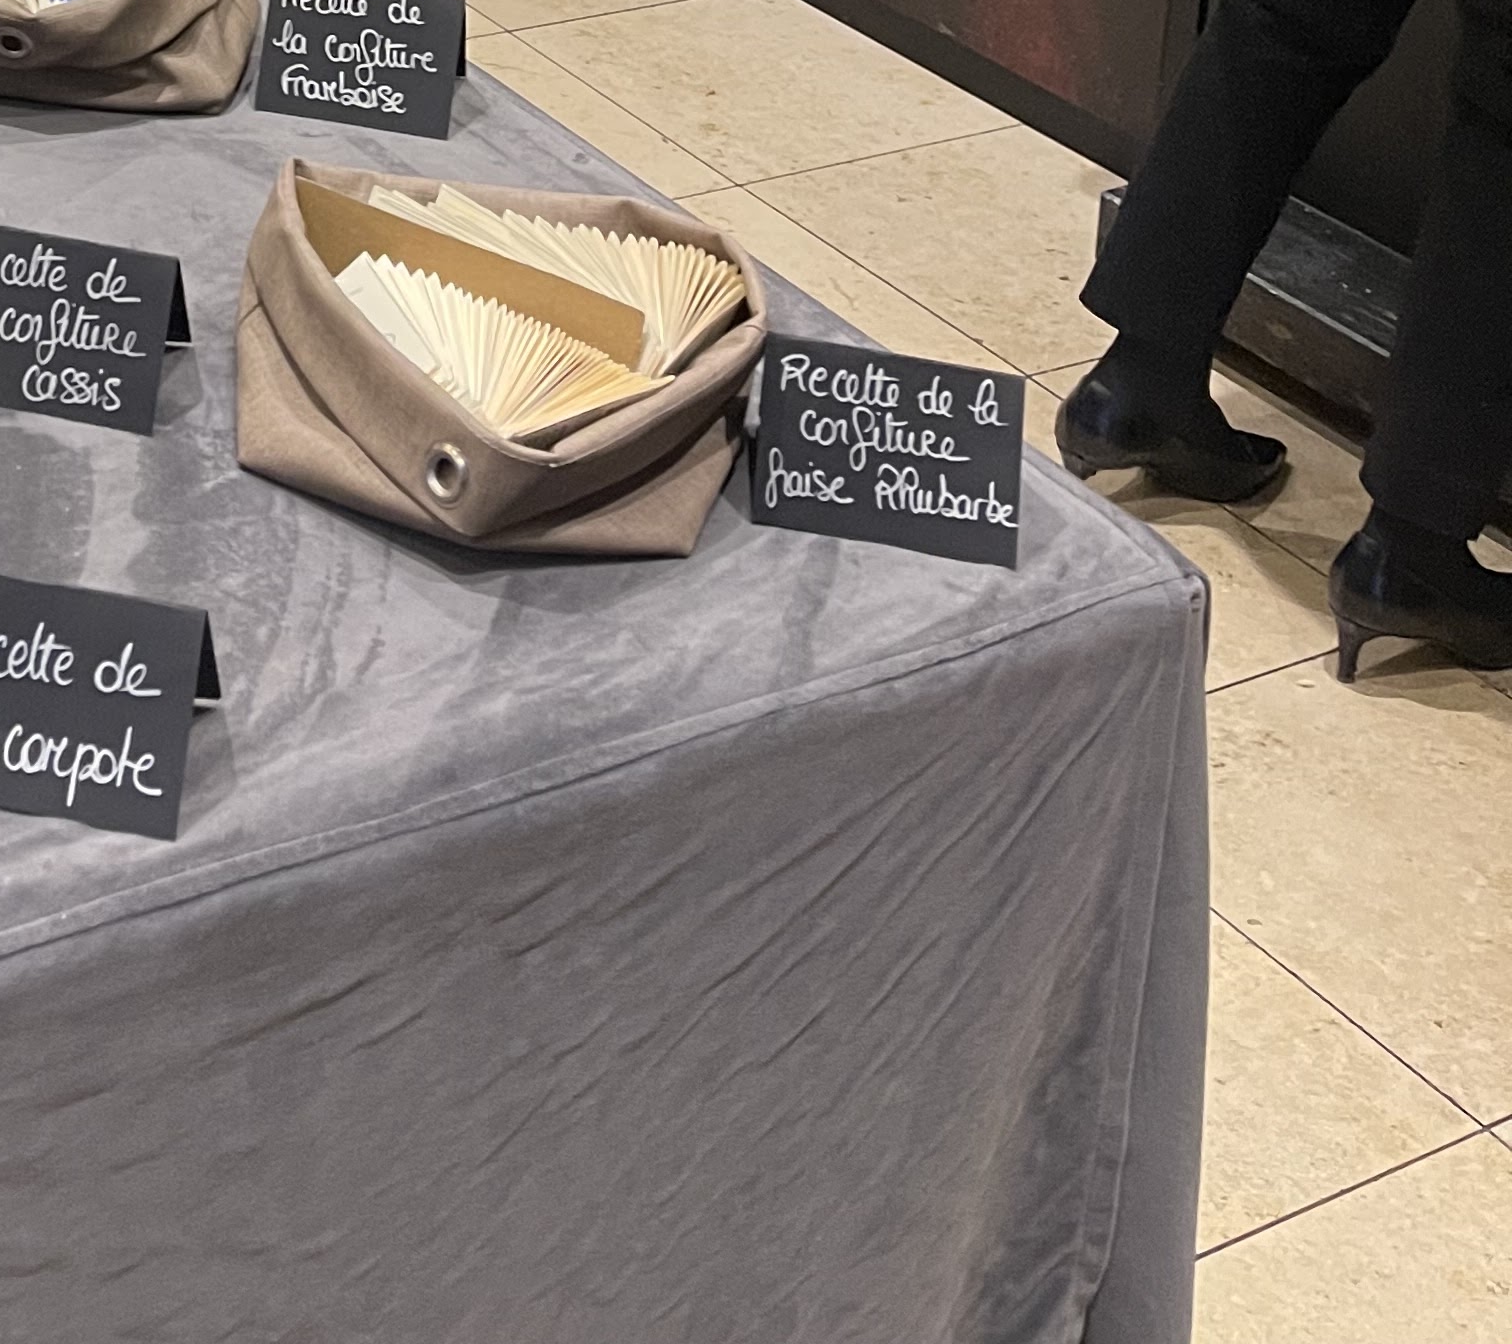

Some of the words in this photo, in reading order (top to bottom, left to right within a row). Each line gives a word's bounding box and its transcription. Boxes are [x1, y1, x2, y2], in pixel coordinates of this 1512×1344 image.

[272, 19, 308, 55] la
[324, 28, 438, 86] confiture
[280, 63, 407, 115] Framboise
[86, 257, 142, 303] de
[21, 364, 123, 412] cassis
[779, 352, 900, 408] Recette
[917, 374, 954, 418] de
[967, 378, 1009, 428] la
[798, 405, 972, 472] confiture
[764, 446, 855, 509] fraise
[92, 641, 163, 698] de
